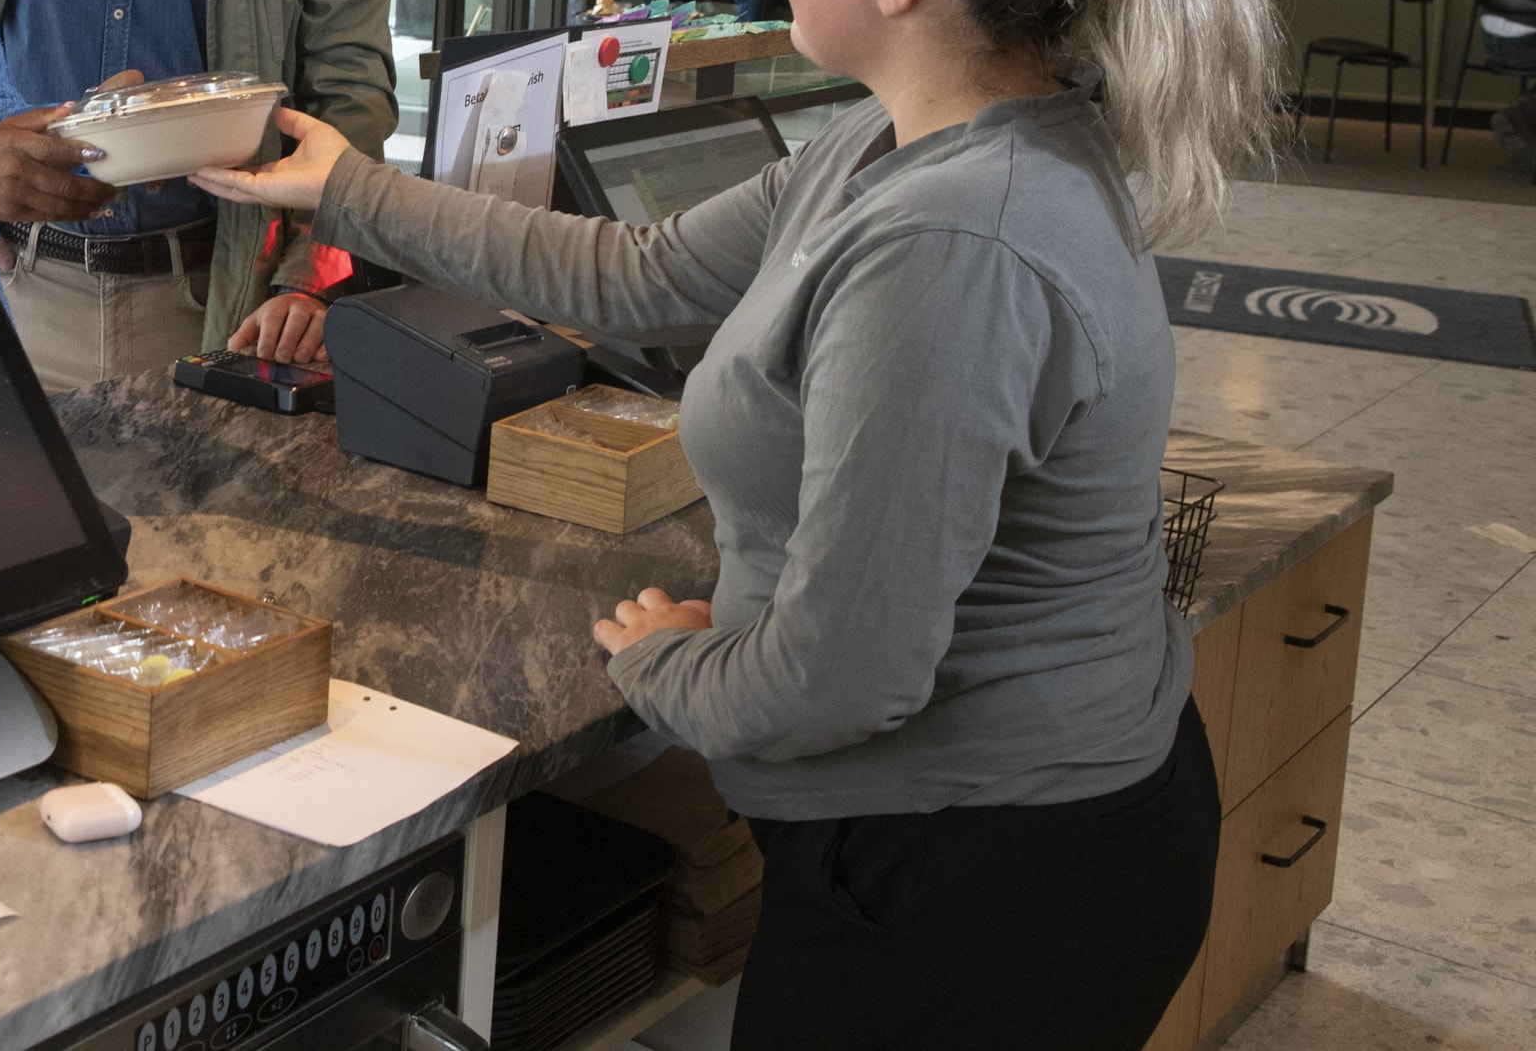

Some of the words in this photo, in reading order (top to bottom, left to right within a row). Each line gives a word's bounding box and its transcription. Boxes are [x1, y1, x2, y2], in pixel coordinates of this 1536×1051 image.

[464, 88, 488, 107] Betal
[527, 71, 544, 86] ish
[169, 1022, 175, 1037] 1
[193, 1007, 201, 1023] 2
[217, 994, 225, 1009] 3
[241, 980, 249, 994] 4
[265, 968, 272, 982] 5
[287, 954, 295, 968] 6
[310, 941, 318, 957] 7
[331, 930, 339, 944] 8
[353, 917, 361, 932] 9
[374, 905, 381, 919] 0
